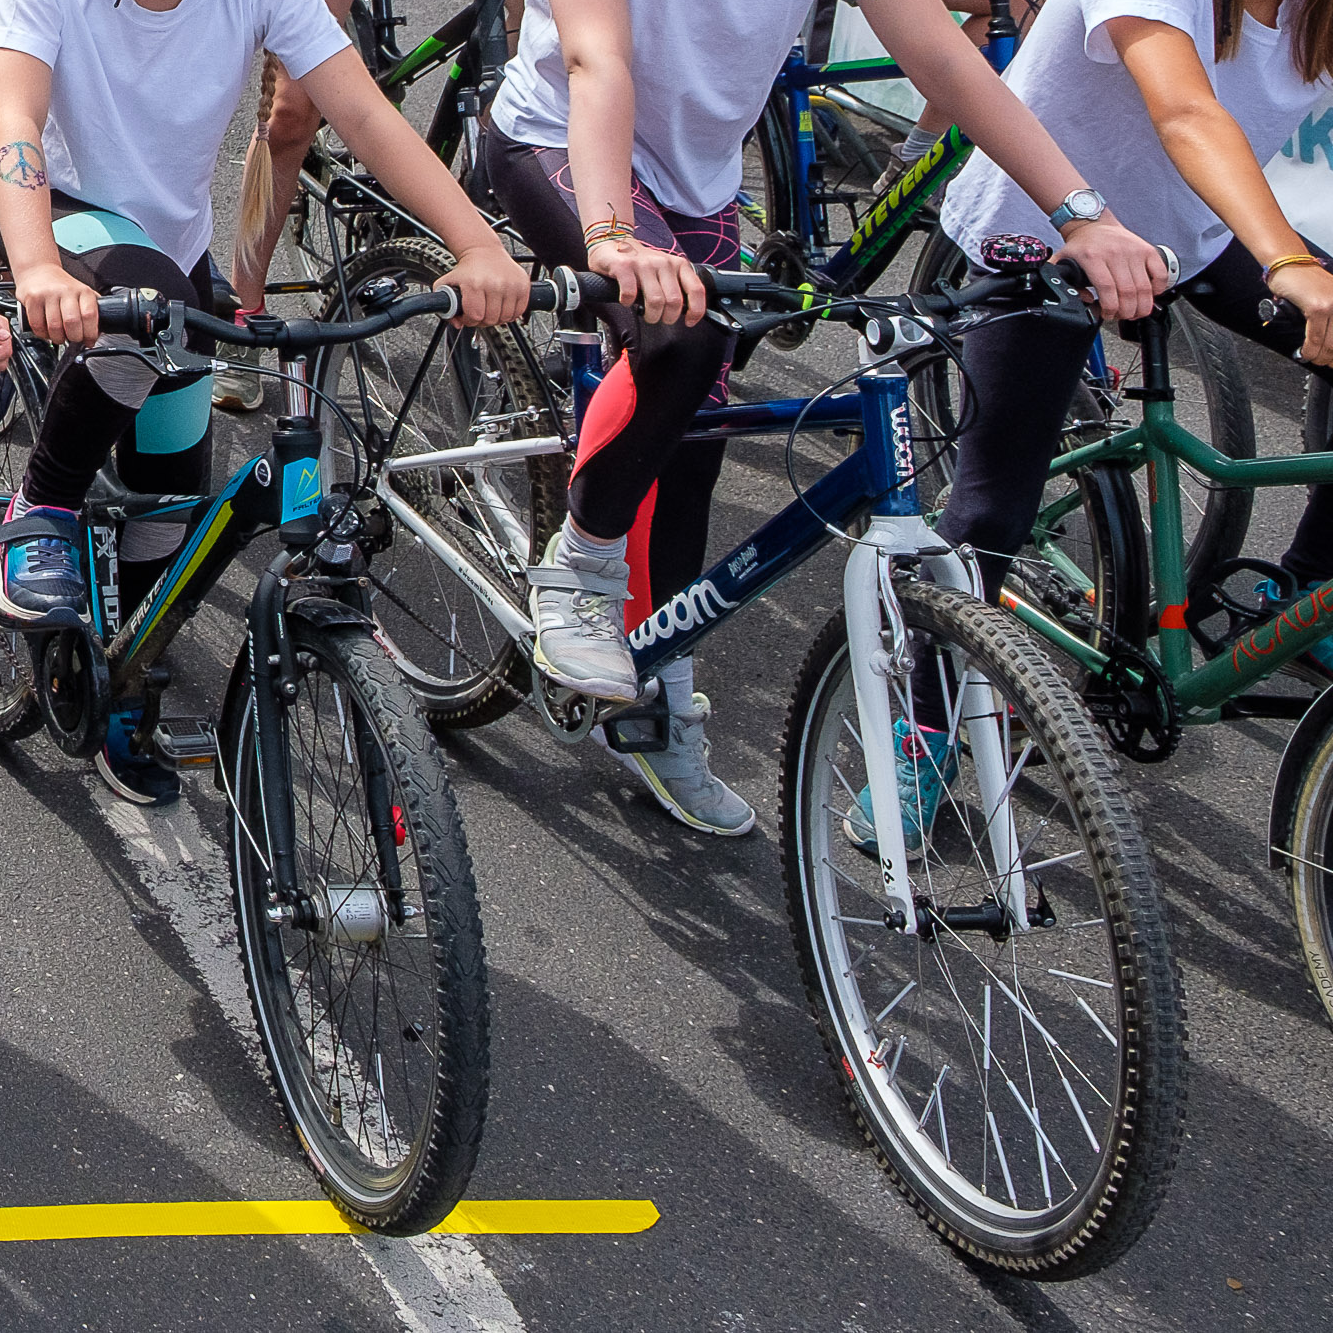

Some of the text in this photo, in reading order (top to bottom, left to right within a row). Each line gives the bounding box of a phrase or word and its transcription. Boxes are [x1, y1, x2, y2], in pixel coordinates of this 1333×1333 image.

[850, 141, 946, 256] STEVENS
[629, 578, 740, 651] woom
[882, 857, 895, 884] 26
[1308, 950, 1333, 1010] ADEMY
